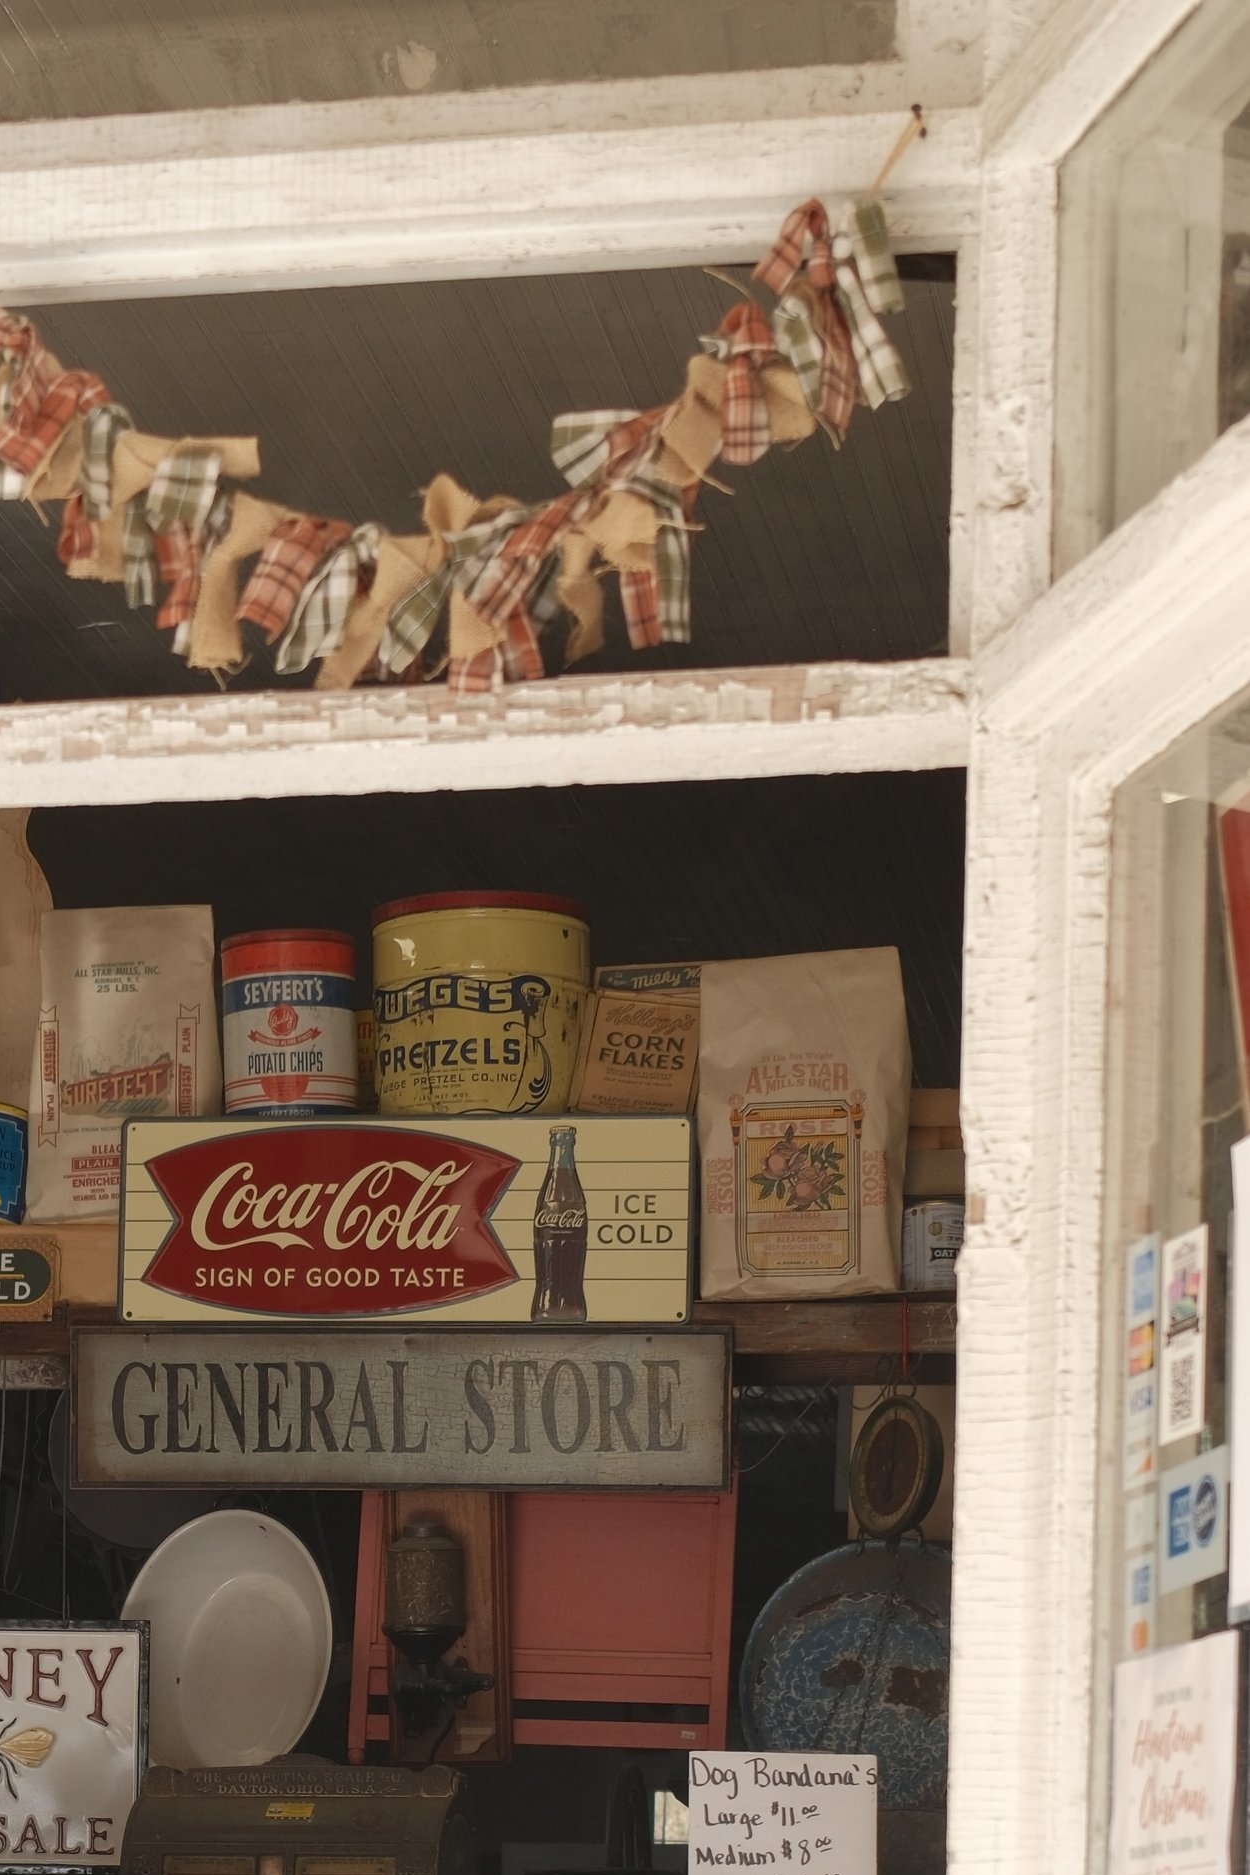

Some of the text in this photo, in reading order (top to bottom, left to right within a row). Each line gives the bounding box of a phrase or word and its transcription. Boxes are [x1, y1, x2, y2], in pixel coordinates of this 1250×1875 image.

[74, 969, 88, 978] ALL
[91, 967, 112, 977] STAR
[631, 971, 681, 989] Milky
[96, 984, 139, 993] 25 LBS.
[243, 976, 325, 1006] SEYFERT'S
[384, 978, 514, 1021] WEGE'S
[605, 1003, 697, 1036] Kellogg's
[182, 1027, 191, 1053] PLAIN
[606, 1031, 687, 1053] CORN
[248, 1050, 324, 1076] POTATO CHIPS
[379, 1037, 521, 1077] PRETZELS
[598, 1047, 686, 1071] FLAKES
[63, 1060, 175, 1109] SURETEST
[413, 1072, 466, 1087] PRETZEL
[745, 1062, 849, 1095] ALL STAR
[46, 1094, 55, 1122] PLAIN
[758, 1119, 837, 1137] ROSE
[78, 1158, 114, 1169] PLAIN
[717, 1157, 734, 1215] ROSE
[861, 1150, 879, 1208] ROSE
[190, 1160, 476, 1252] Coca-Cola
[613, 1194, 658, 1215] ICE
[534, 1208, 587, 1231] Coca-Cola
[596, 1223, 675, 1245] COLD
[194, 1267, 466, 1289] SIGN OF GOOD TASTE
[110, 1357, 688, 1457] GENERAL STORE
[193, 1771, 376, 1786] THE COMPUTING SCALE
[217, 1783, 284, 1797] DAYTON,
[690, 1756, 878, 1800] Dog Bandana's
[703, 1803, 764, 1841] Large
[694, 1844, 776, 1867] Medium
